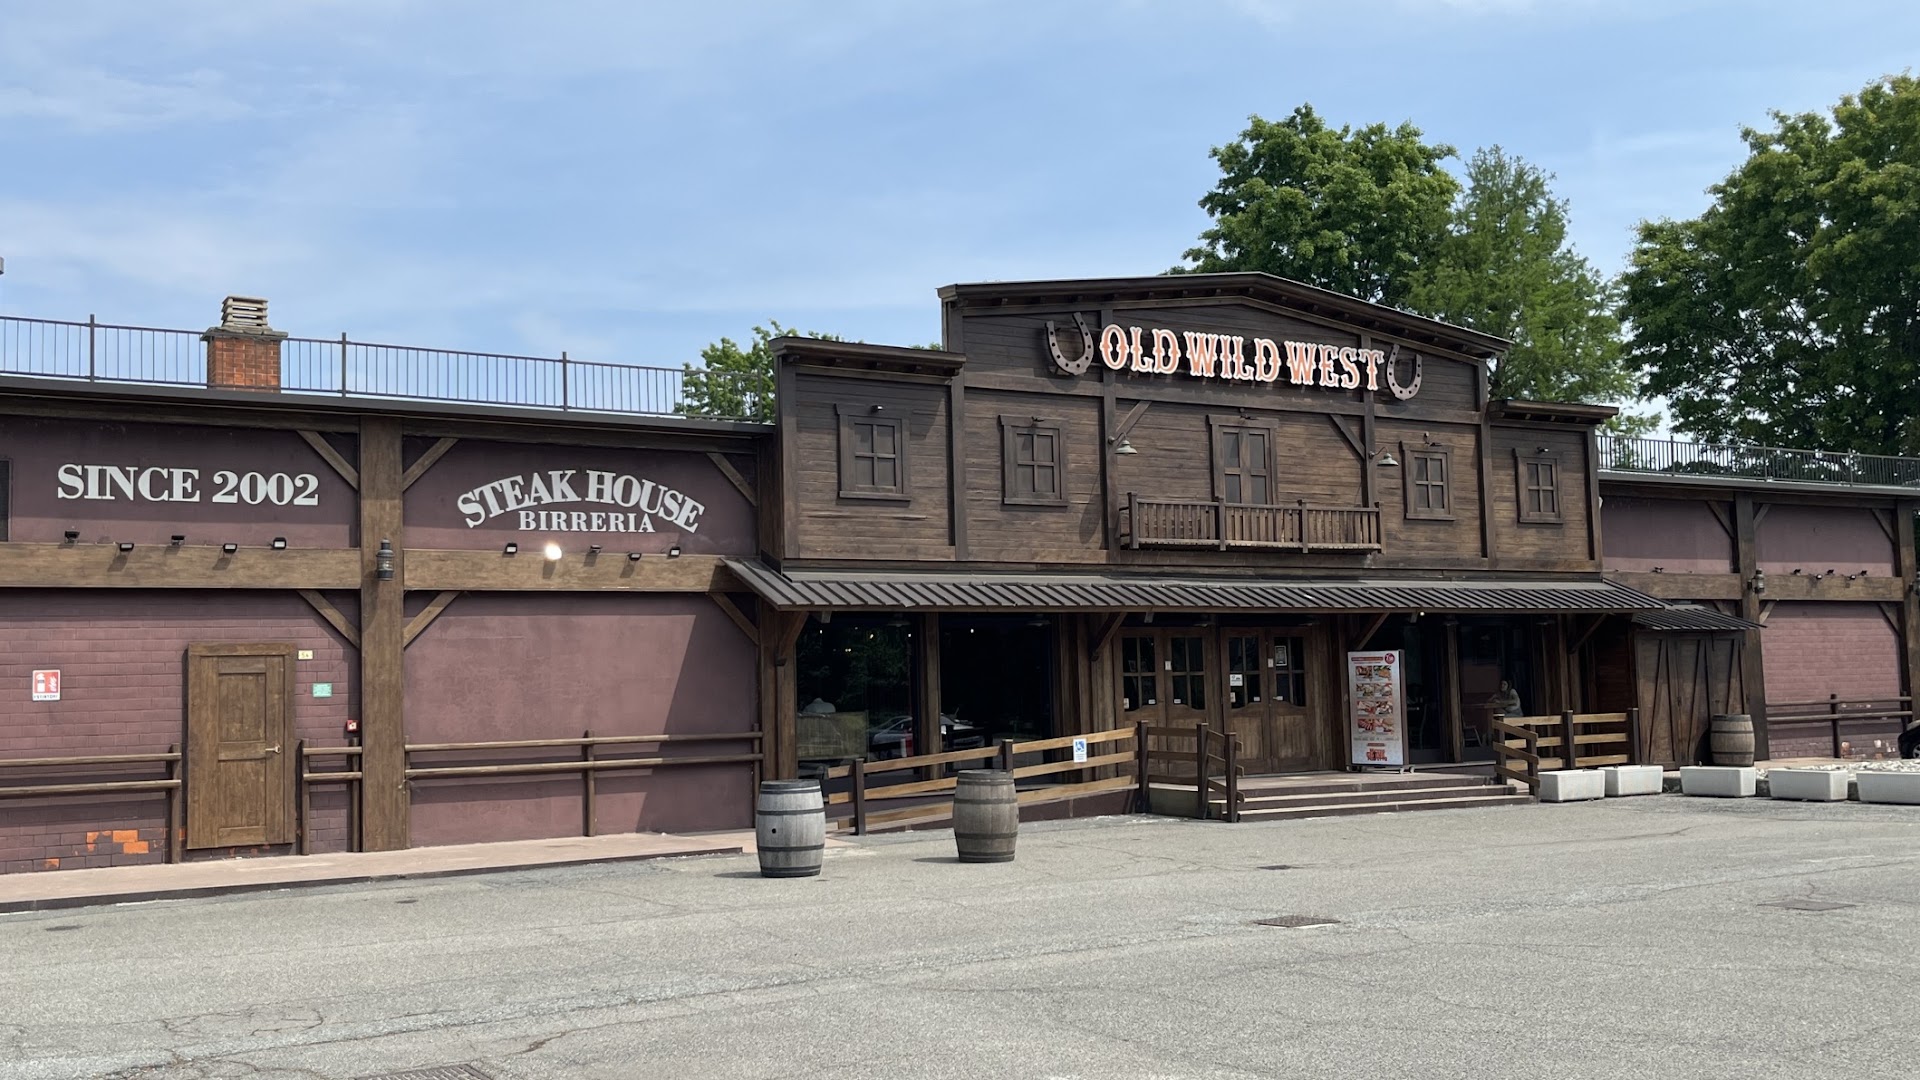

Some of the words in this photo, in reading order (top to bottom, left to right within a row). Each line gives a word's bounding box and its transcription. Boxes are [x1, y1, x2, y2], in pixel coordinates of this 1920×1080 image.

[1100, 323, 1181, 374] OLD
[1182, 331, 1281, 382] WILD
[1284, 340, 1385, 391] WEST
[57, 463, 201, 502] SINCE
[212, 470, 319, 506] 2002
[457, 470, 582, 529] STEAK
[585, 469, 706, 534] HOUSE
[518, 510, 656, 533] BIRRERIA
